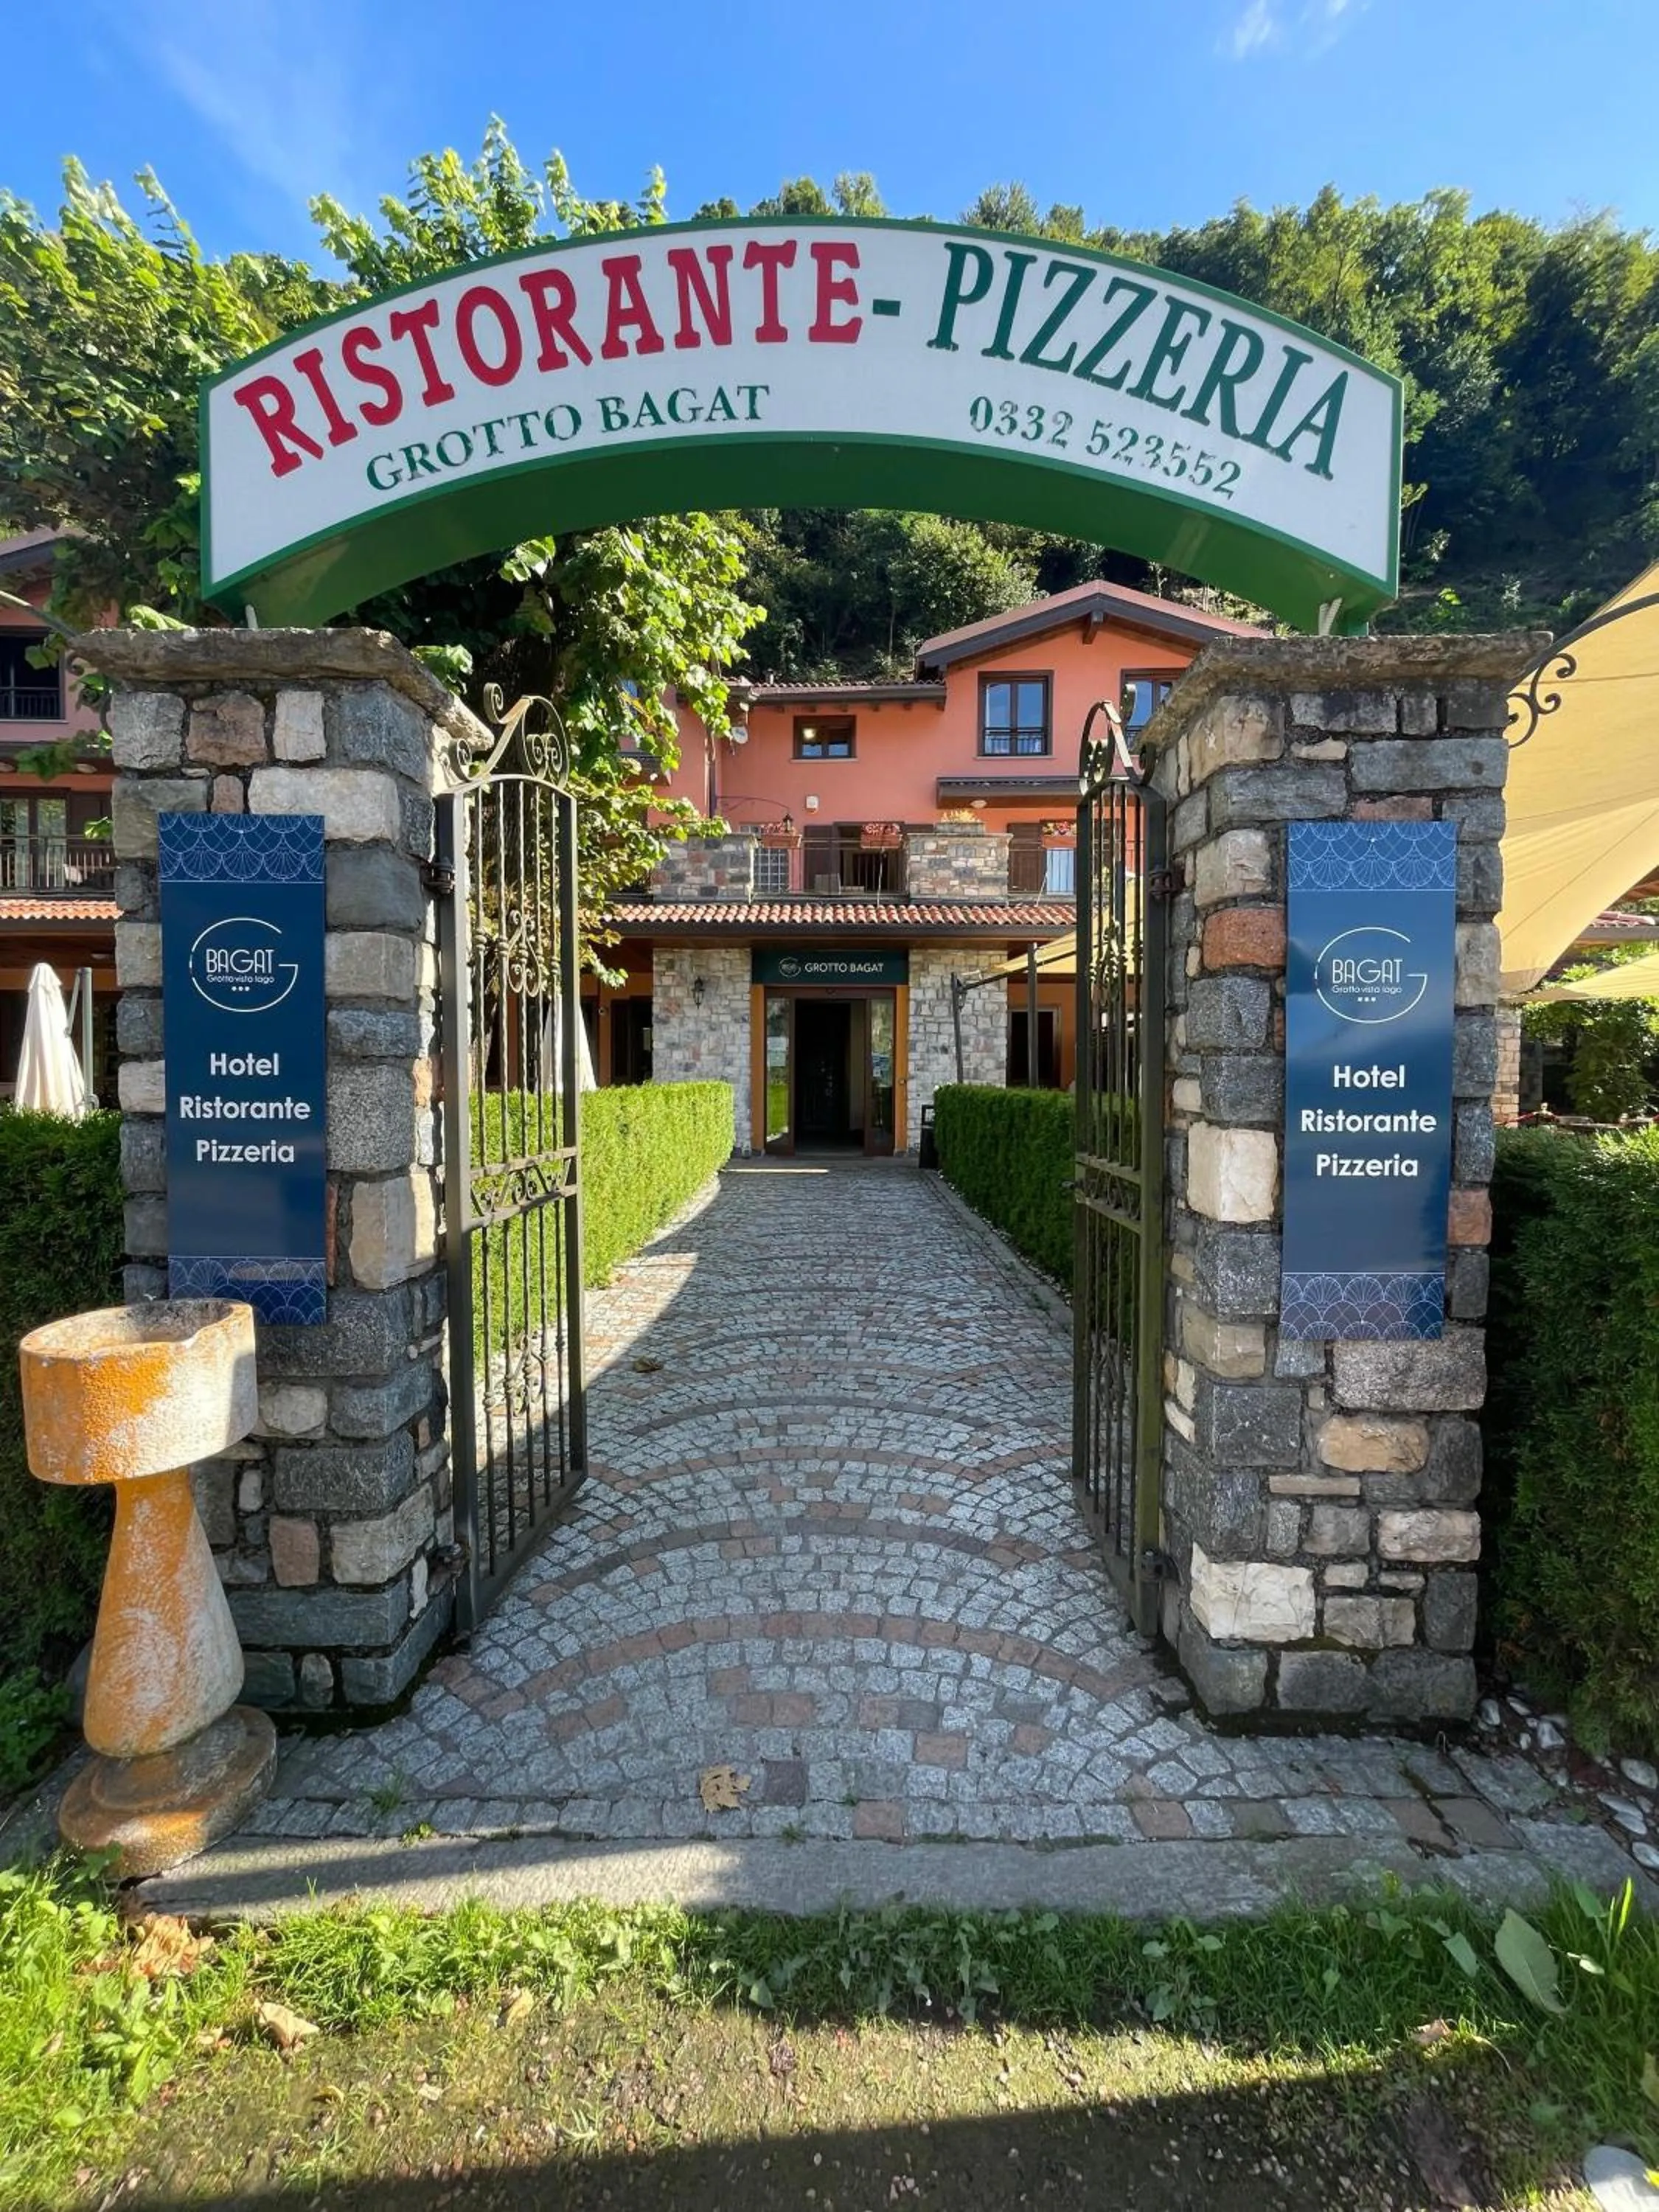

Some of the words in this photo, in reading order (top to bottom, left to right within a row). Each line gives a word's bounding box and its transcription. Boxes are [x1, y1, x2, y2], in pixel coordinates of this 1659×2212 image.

[926, 241, 1349, 481] PIZZERIA
[366, 404, 582, 491] GROTTO
[595, 385, 770, 434] BAGAT
[970, 396, 1073, 449] 0332
[1085, 419, 1242, 501] 523552
[206, 949, 274, 974] BAGAT
[804, 962, 847, 973] GROTTO
[849, 962, 884, 973] BAGAT
[1332, 959, 1403, 984] BAGAT
[210, 1052, 279, 1076] Hotel
[1334, 1065, 1405, 1088] Hotel
[179, 1095, 311, 1120] Ristorante
[1301, 1108, 1437, 1133] Ristorante
[196, 1139, 295, 1163] Pizzeria
[1316, 1153, 1419, 1177] Pizzeria
